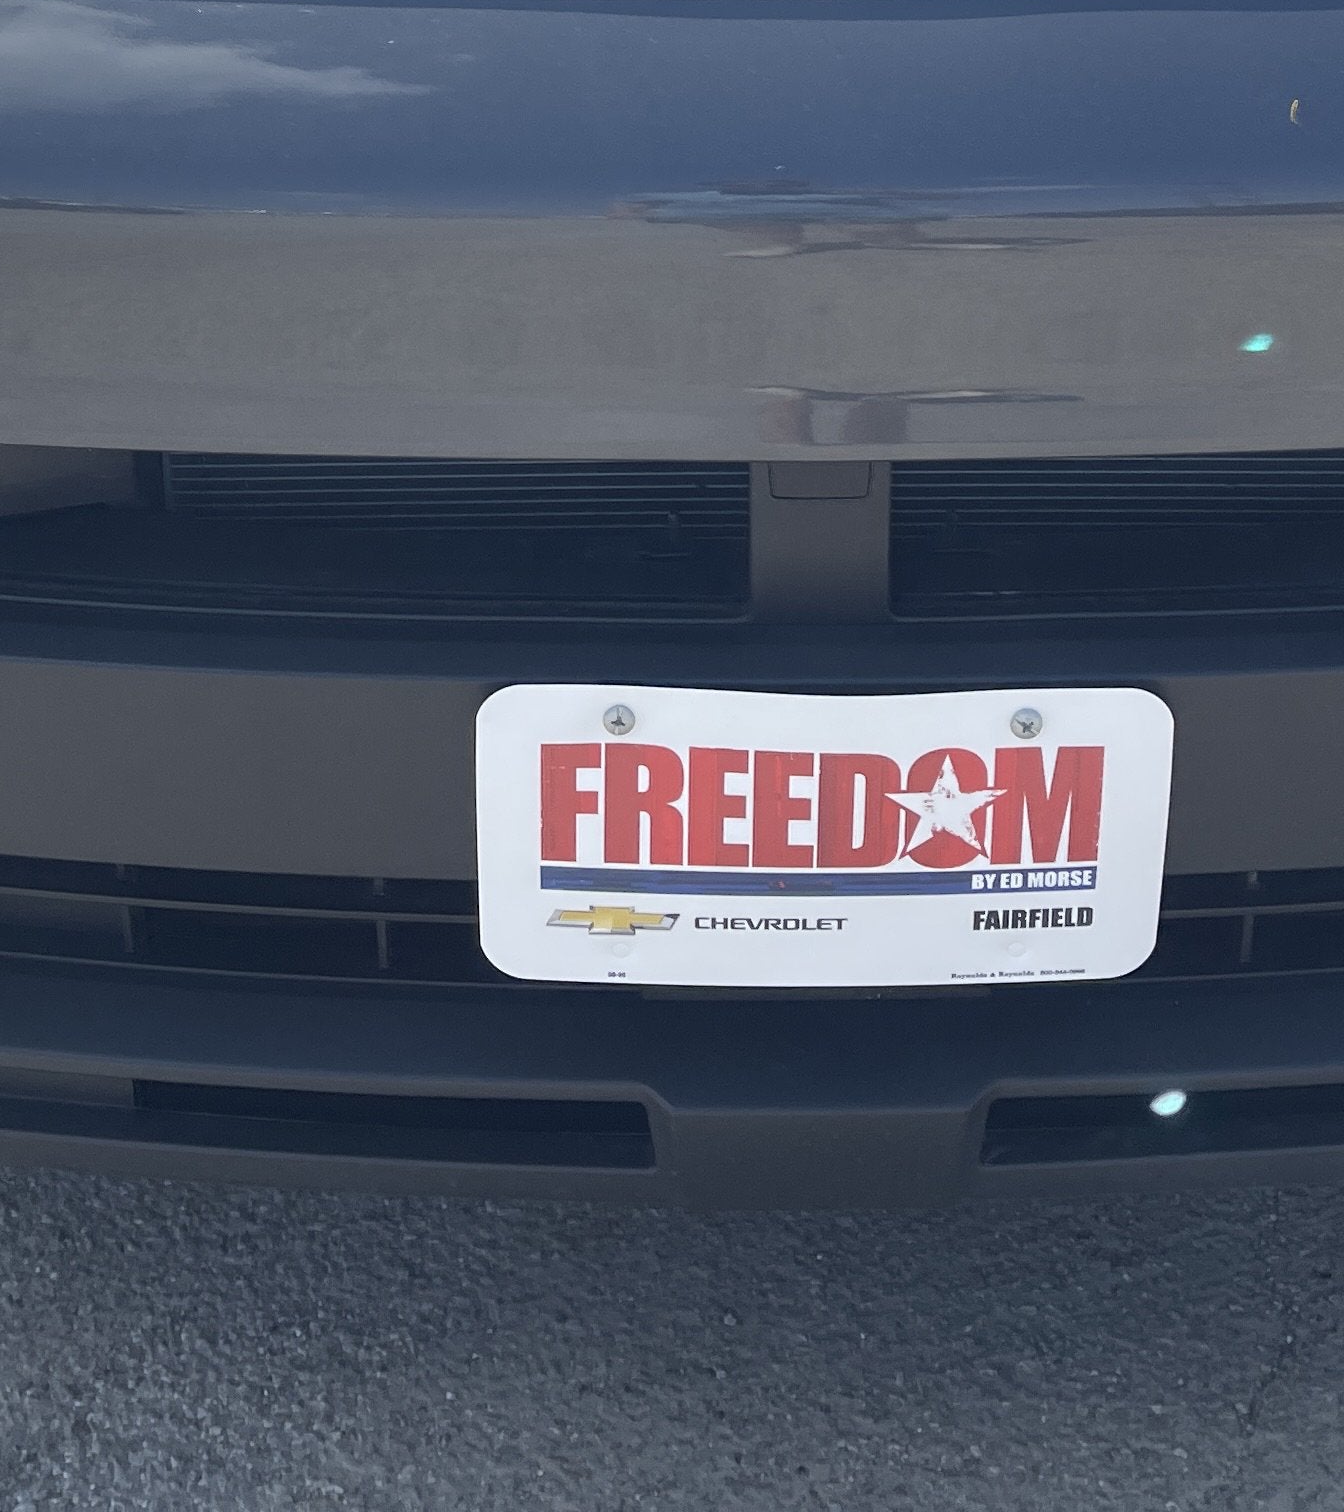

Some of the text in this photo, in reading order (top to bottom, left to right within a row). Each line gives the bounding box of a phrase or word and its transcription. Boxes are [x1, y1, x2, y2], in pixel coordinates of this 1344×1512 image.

[540, 742, 1105, 869] FREEDOM
[971, 870, 1093, 890] BY ED MORSE
[694, 917, 849, 931] CHEVROLET
[972, 906, 1094, 931] FAIRFIELD
